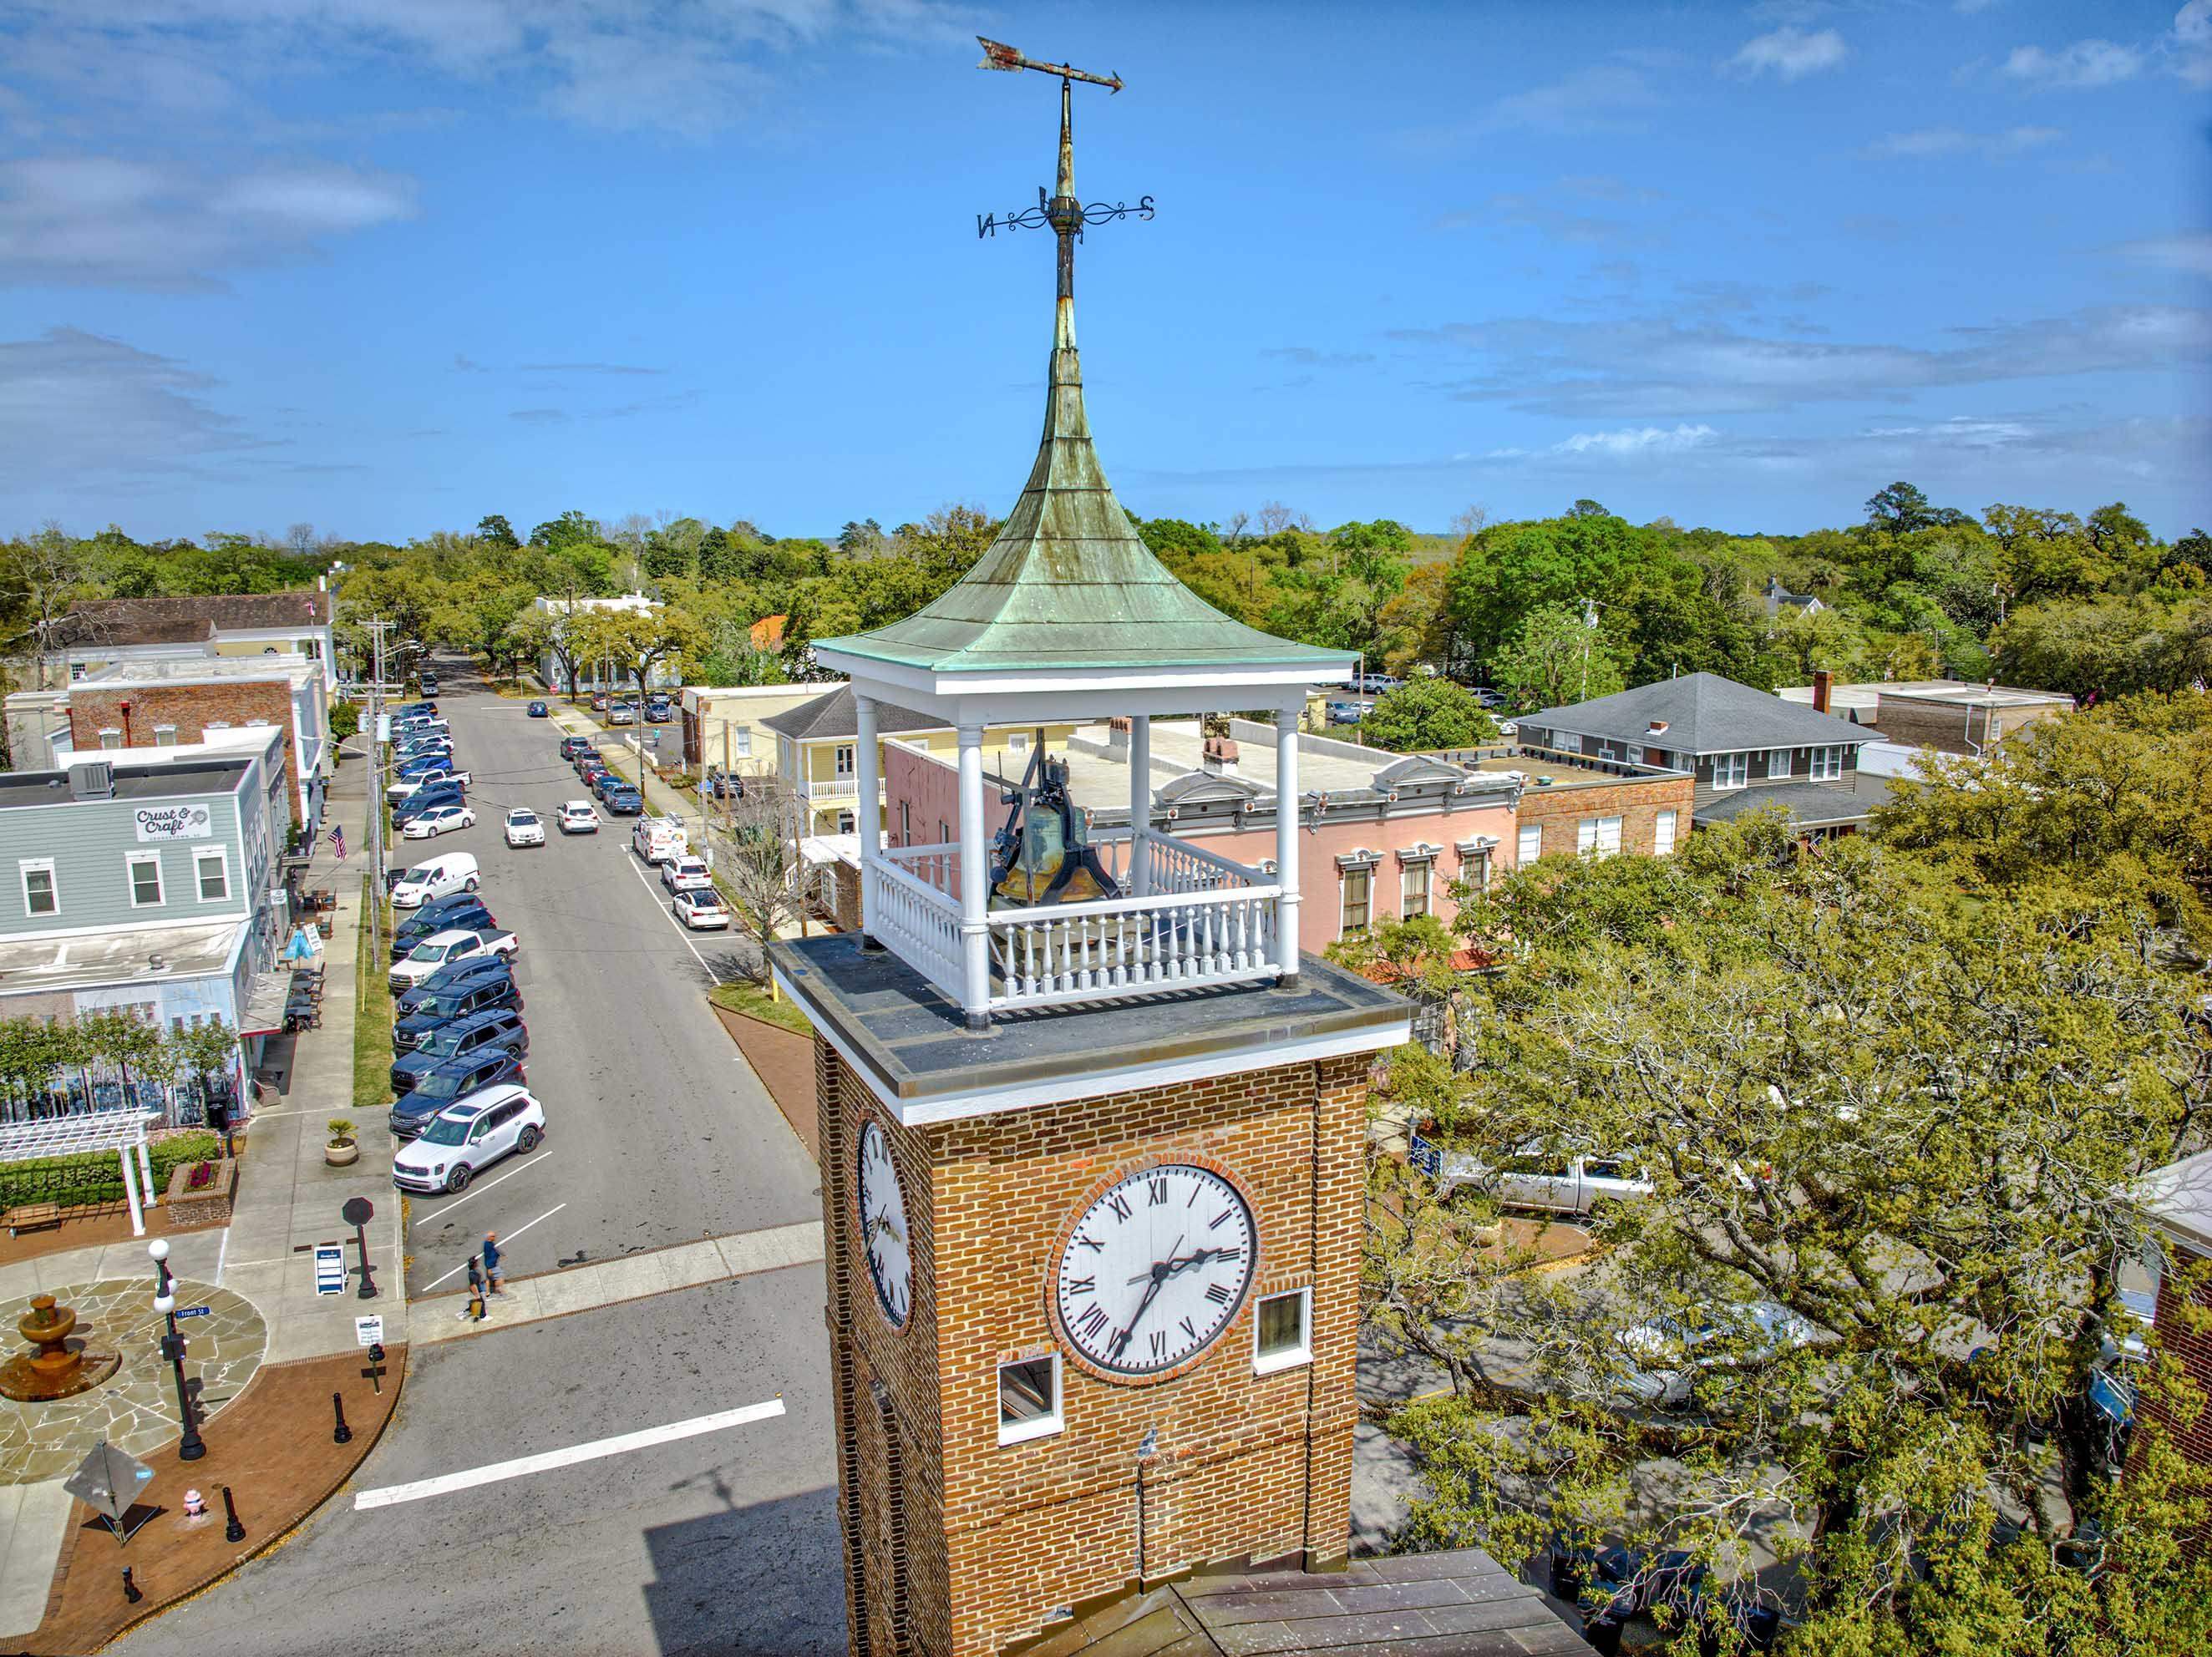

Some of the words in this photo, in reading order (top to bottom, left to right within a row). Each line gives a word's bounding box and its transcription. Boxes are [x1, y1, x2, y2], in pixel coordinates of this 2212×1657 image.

[1139, 195, 1154, 220] S
[137, 809, 177, 823] Crust
[179, 807, 190, 818] &
[145, 819, 185, 835] Craft
[1149, 1178, 1167, 1207] XII
[1108, 1193, 1133, 1224] XI
[1149, 1330, 1166, 1358] VI
